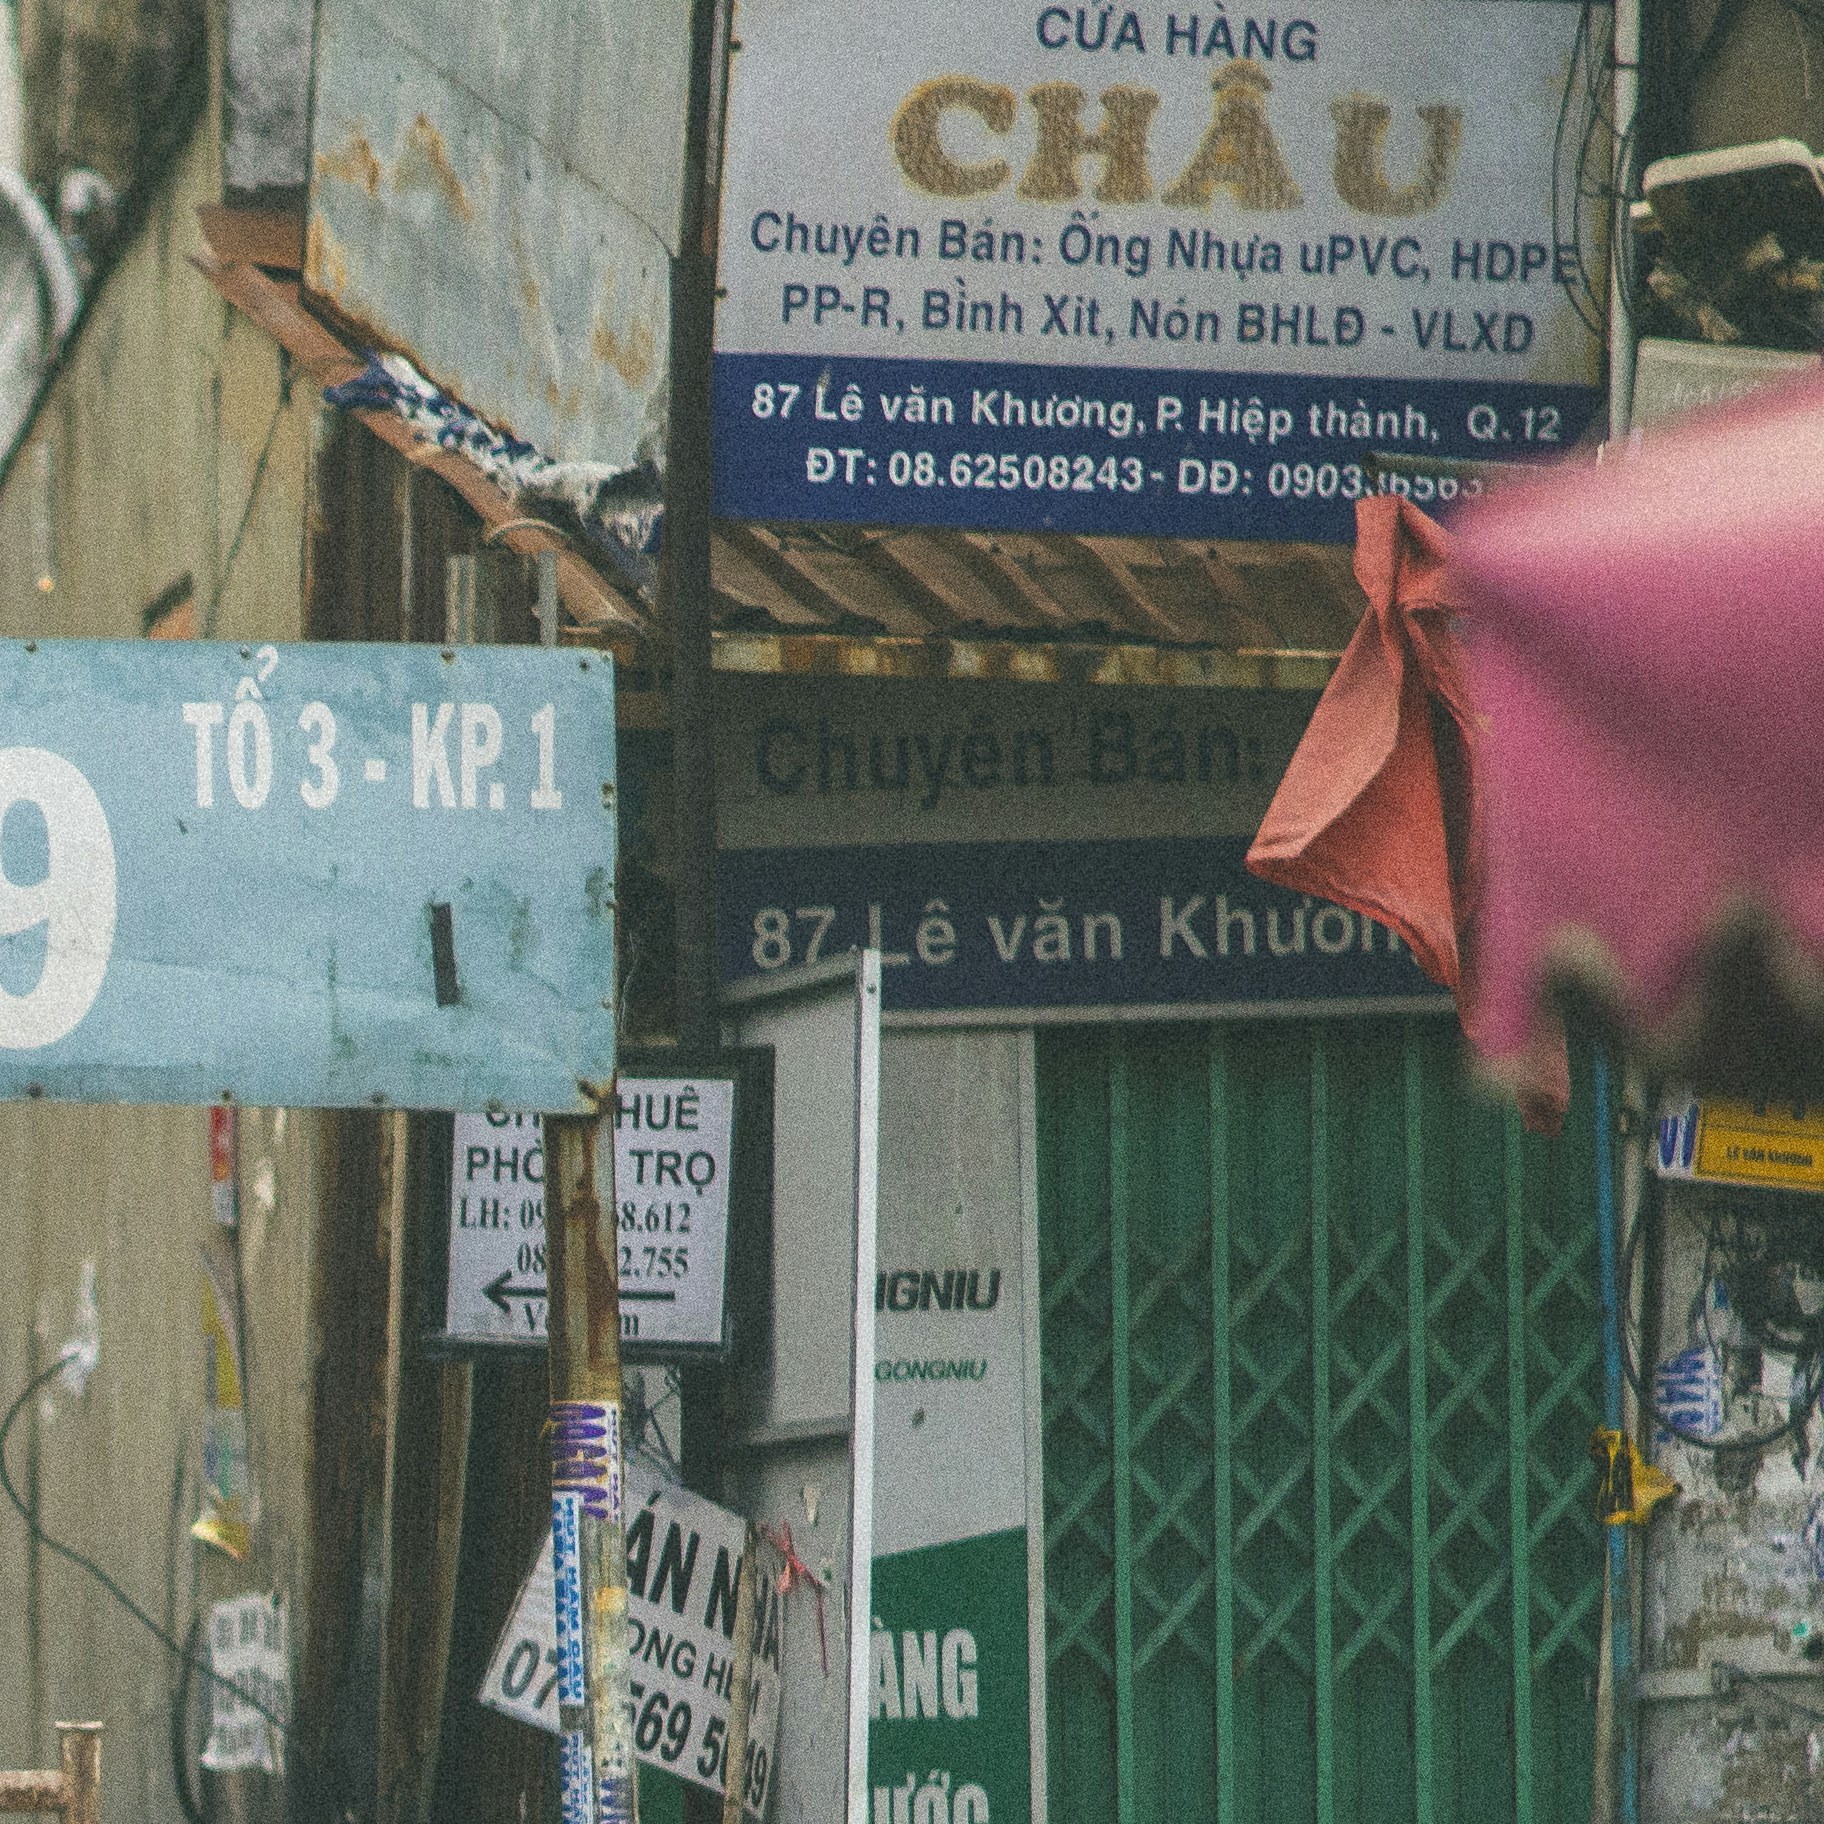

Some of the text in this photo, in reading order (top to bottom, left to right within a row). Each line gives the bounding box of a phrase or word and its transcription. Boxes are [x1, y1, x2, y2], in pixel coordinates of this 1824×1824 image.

[1166, 0, 1318, 62] HÀNG
[890, 60, 1465, 218] CHÂU
[750, 208, 1579, 288] Chuyên Bán: Ống Nhựa uPVC, HDPE
[782, 283, 906, 336] PP-R,
[921, 277, 1025, 337] Bình
[1129, 295, 1221, 344] Nón
[1236, 303, 1367, 349] BHLĐ
[1412, 307, 1537, 356] VLXD
[752, 382, 801, 420] 87
[814, 382, 864, 422] Lê
[880, 385, 952, 424] văn
[971, 389, 1146, 439] Khương,
[1157, 396, 1184, 433] P.
[1199, 396, 1294, 444] Hiệp
[1308, 399, 1440, 444] thành,
[806, 448, 878, 485] ĐT:
[1178, 458, 1252, 496] DĐ:
[182, 645, 280, 810] TỔ
[296, 701, 340, 810] 3
[410, 701, 505, 810] KP.
[529, 701, 563, 810] 1
[756, 714, 1055, 811] Chuyên
[752, 892, 1414, 969] 87 Lê văn Khươn
[616, 1084, 700, 1131] HUÊ
[629, 1149, 716, 1197] TRỌ
[458, 1198, 510, 1230] LH:
[626, 1490, 701, 1614] ÁN
[869, 1613, 981, 1721] ÀNG
